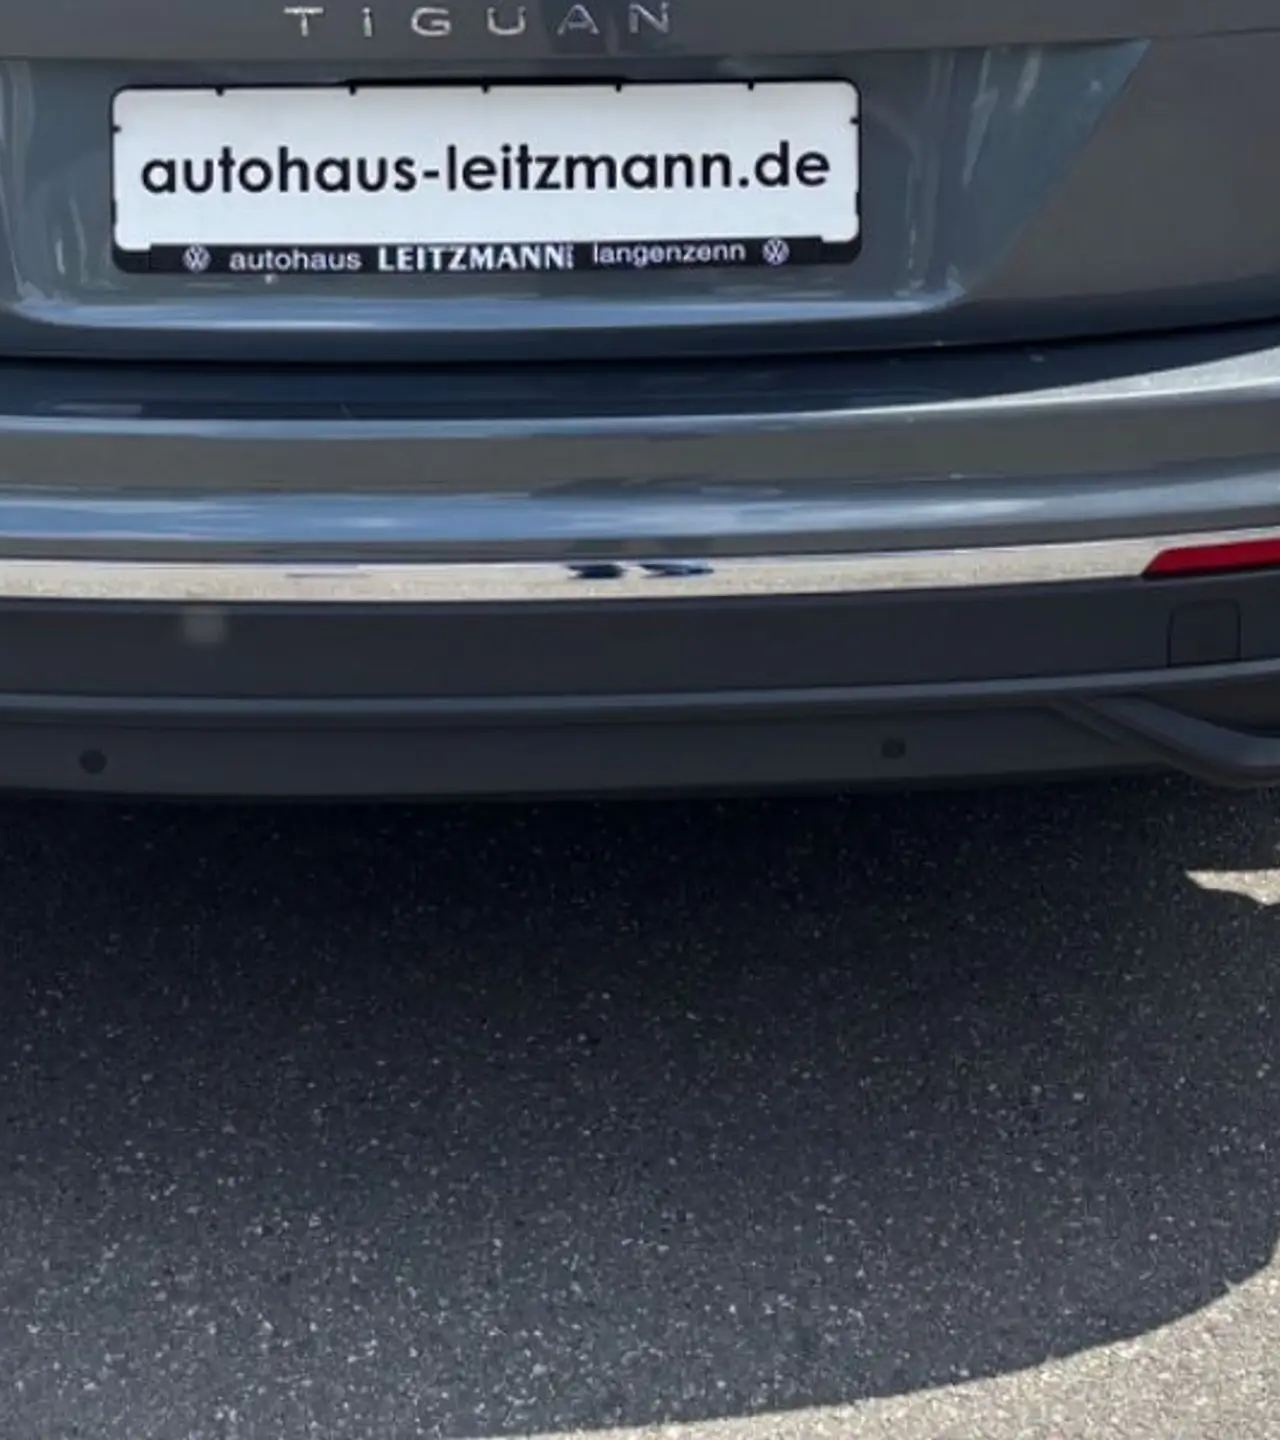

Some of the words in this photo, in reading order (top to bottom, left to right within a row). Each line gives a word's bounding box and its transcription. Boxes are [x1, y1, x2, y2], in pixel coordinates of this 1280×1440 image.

[283, 1, 671, 38] TIGUAN
[140, 140, 830, 194] autohaus-leitzmann.de
[228, 248, 362, 271] autohaus
[378, 244, 564, 271] LEITZMANN
[593, 241, 746, 267] langenzenn
